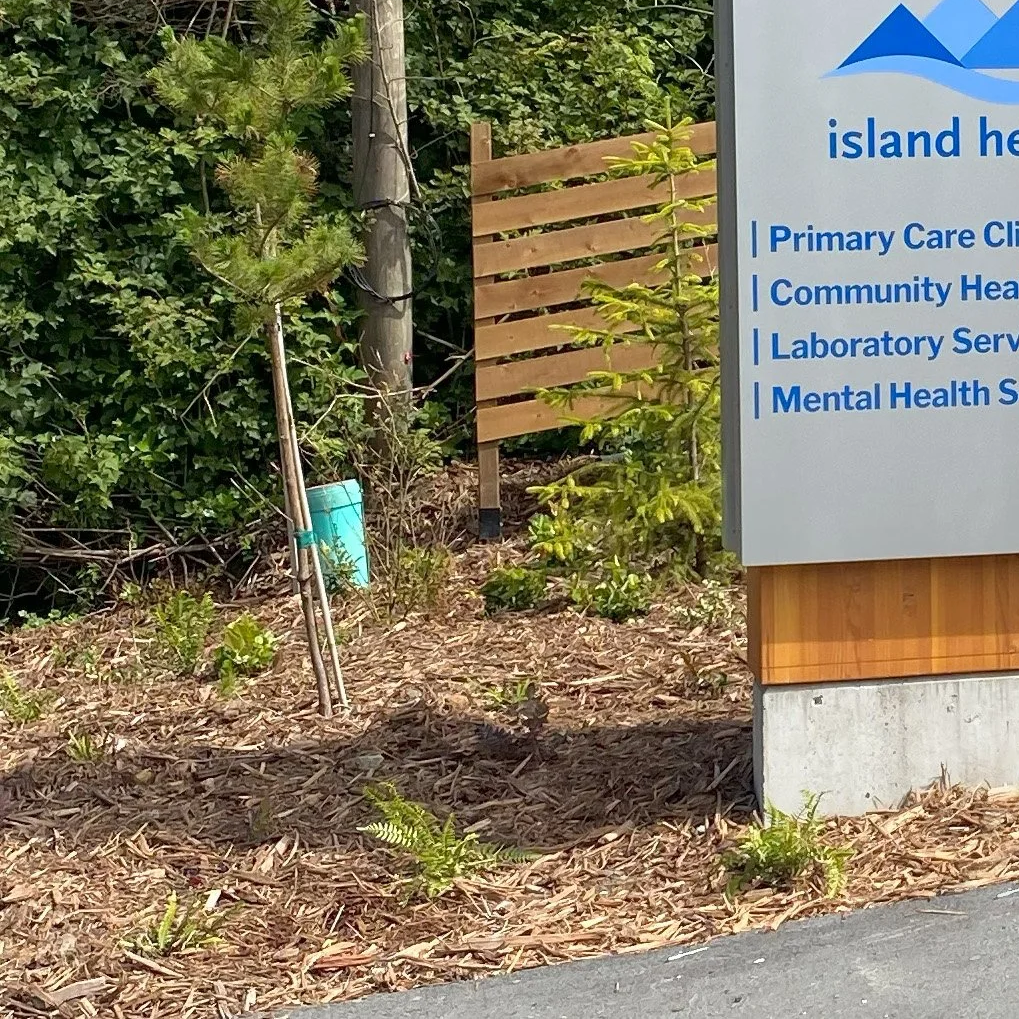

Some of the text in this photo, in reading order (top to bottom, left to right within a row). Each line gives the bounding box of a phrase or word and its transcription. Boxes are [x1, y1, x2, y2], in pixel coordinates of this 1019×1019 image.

[828, 117, 960, 159] island
[769, 224, 895, 256] Primary
[903, 222, 976, 250] Care
[770, 276, 952, 308] Community
[771, 331, 945, 361] Laboratory
[772, 383, 881, 413] Mental
[890, 380, 990, 409] Health
